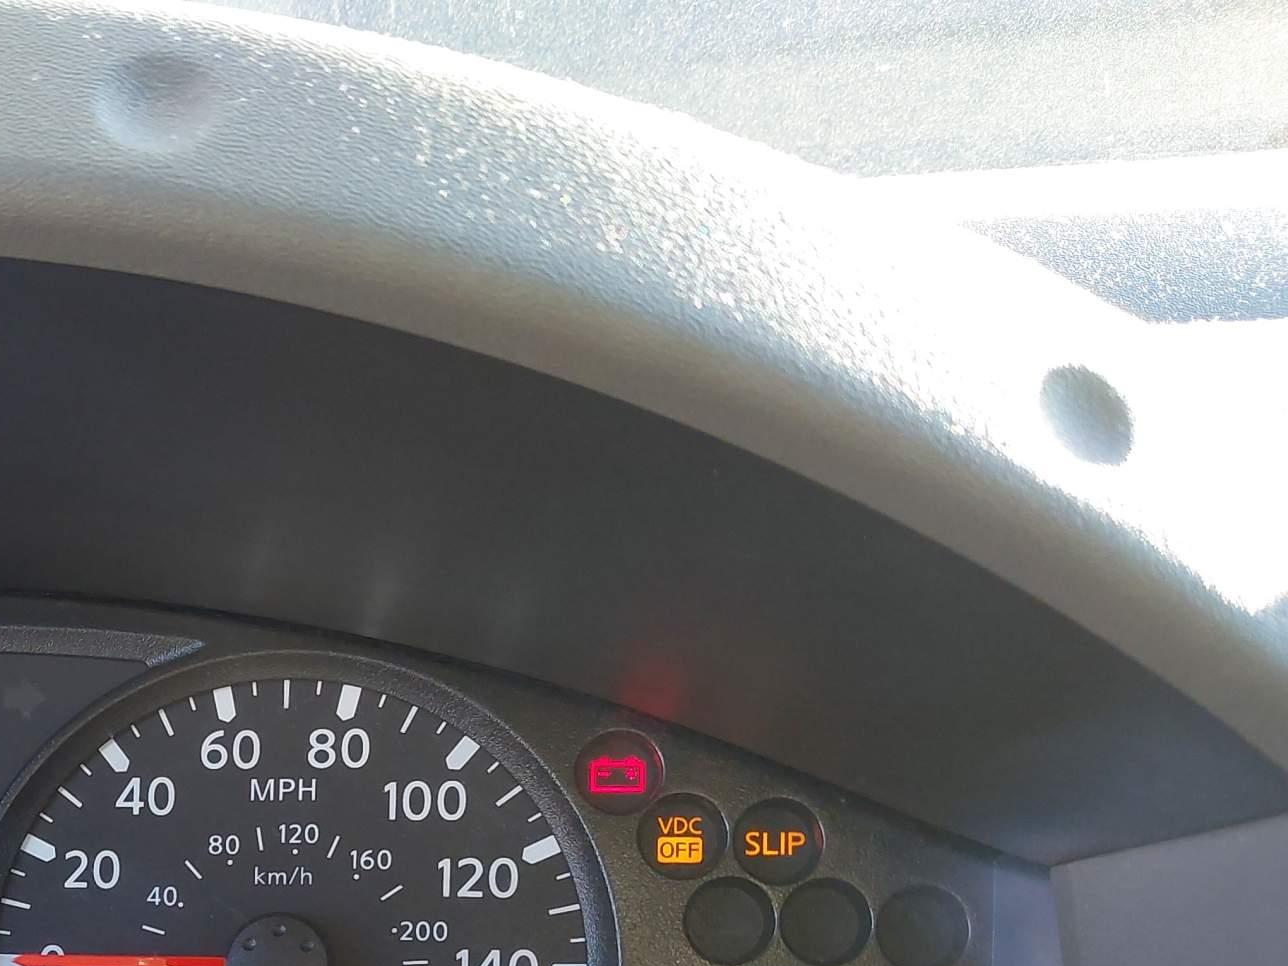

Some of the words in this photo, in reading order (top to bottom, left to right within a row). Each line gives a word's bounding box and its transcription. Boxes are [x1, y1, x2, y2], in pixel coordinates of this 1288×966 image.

[200, 729, 262, 770] 60
[307, 729, 370, 769] 80
[116, 776, 175, 816] 40
[250, 779, 317, 802] MPH
[383, 780, 467, 821] 100
[278, 824, 319, 844] 120
[658, 816, 702, 836] VDC
[208, 835, 240, 856] 80
[659, 839, 701, 860] OFF
[744, 832, 805, 856] SLIP
[64, 850, 120, 890] 20
[350, 849, 392, 871] 160
[254, 865, 313, 886] km/h
[437, 857, 518, 899] 120
[146, 886, 178, 907] 40
[399, 921, 448, 942] 200
